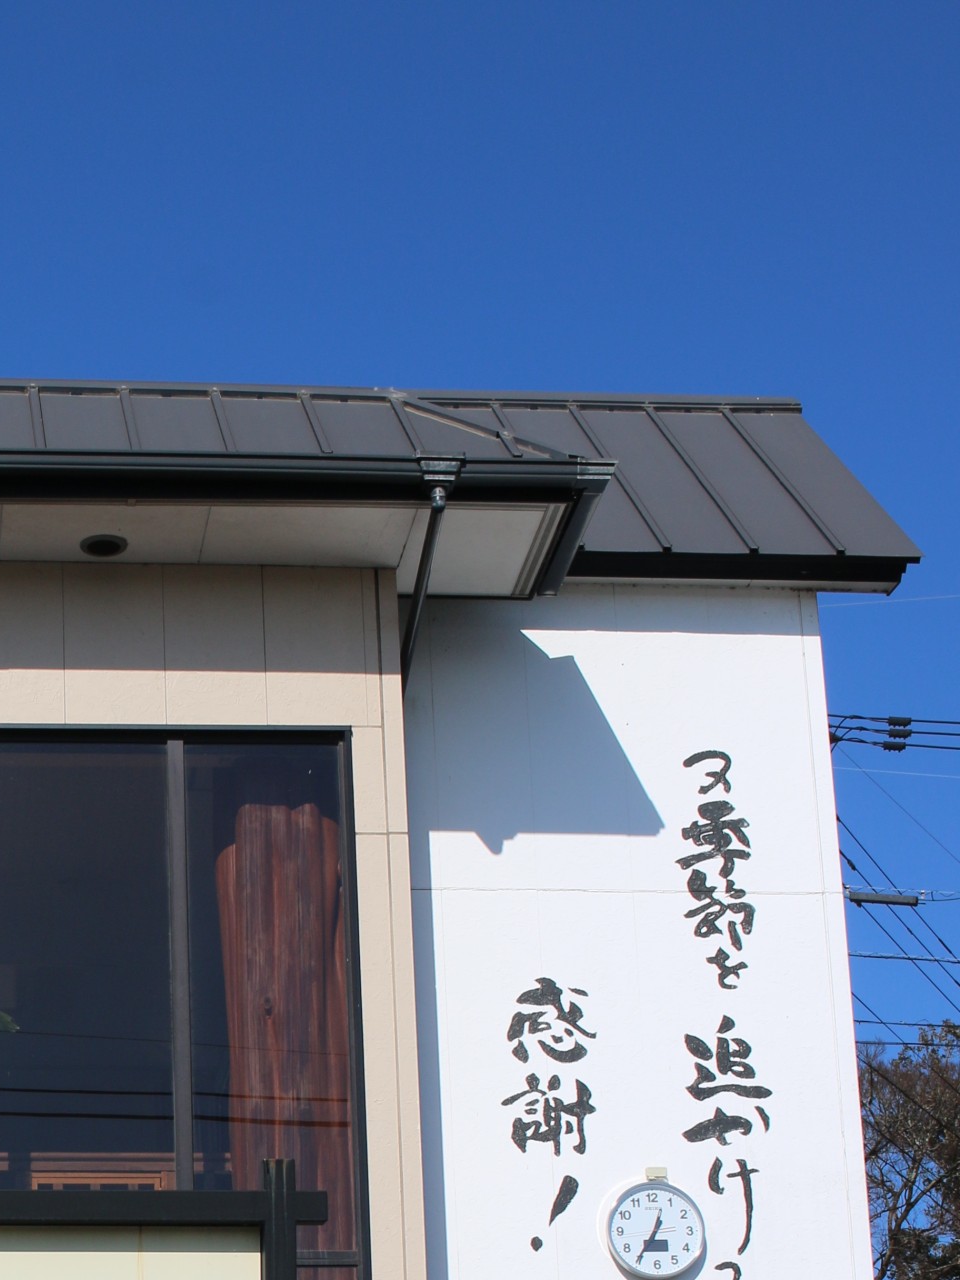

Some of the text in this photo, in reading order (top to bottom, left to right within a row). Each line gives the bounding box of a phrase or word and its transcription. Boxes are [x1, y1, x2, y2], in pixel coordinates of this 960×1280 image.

[630, 1198, 641, 1208] 11
[646, 1193, 659, 1203] 12
[667, 1198, 673, 1207] 1
[618, 1210, 631, 1220] 10
[680, 1209, 688, 1219] 2
[616, 1226, 624, 1236] 9
[686, 1226, 694, 1236] 3
[623, 1243, 631, 1253] 8
[682, 1243, 690, 1252] 4
[653, 1260, 661, 1270] 6
[671, 1255, 679, 1265] 5
